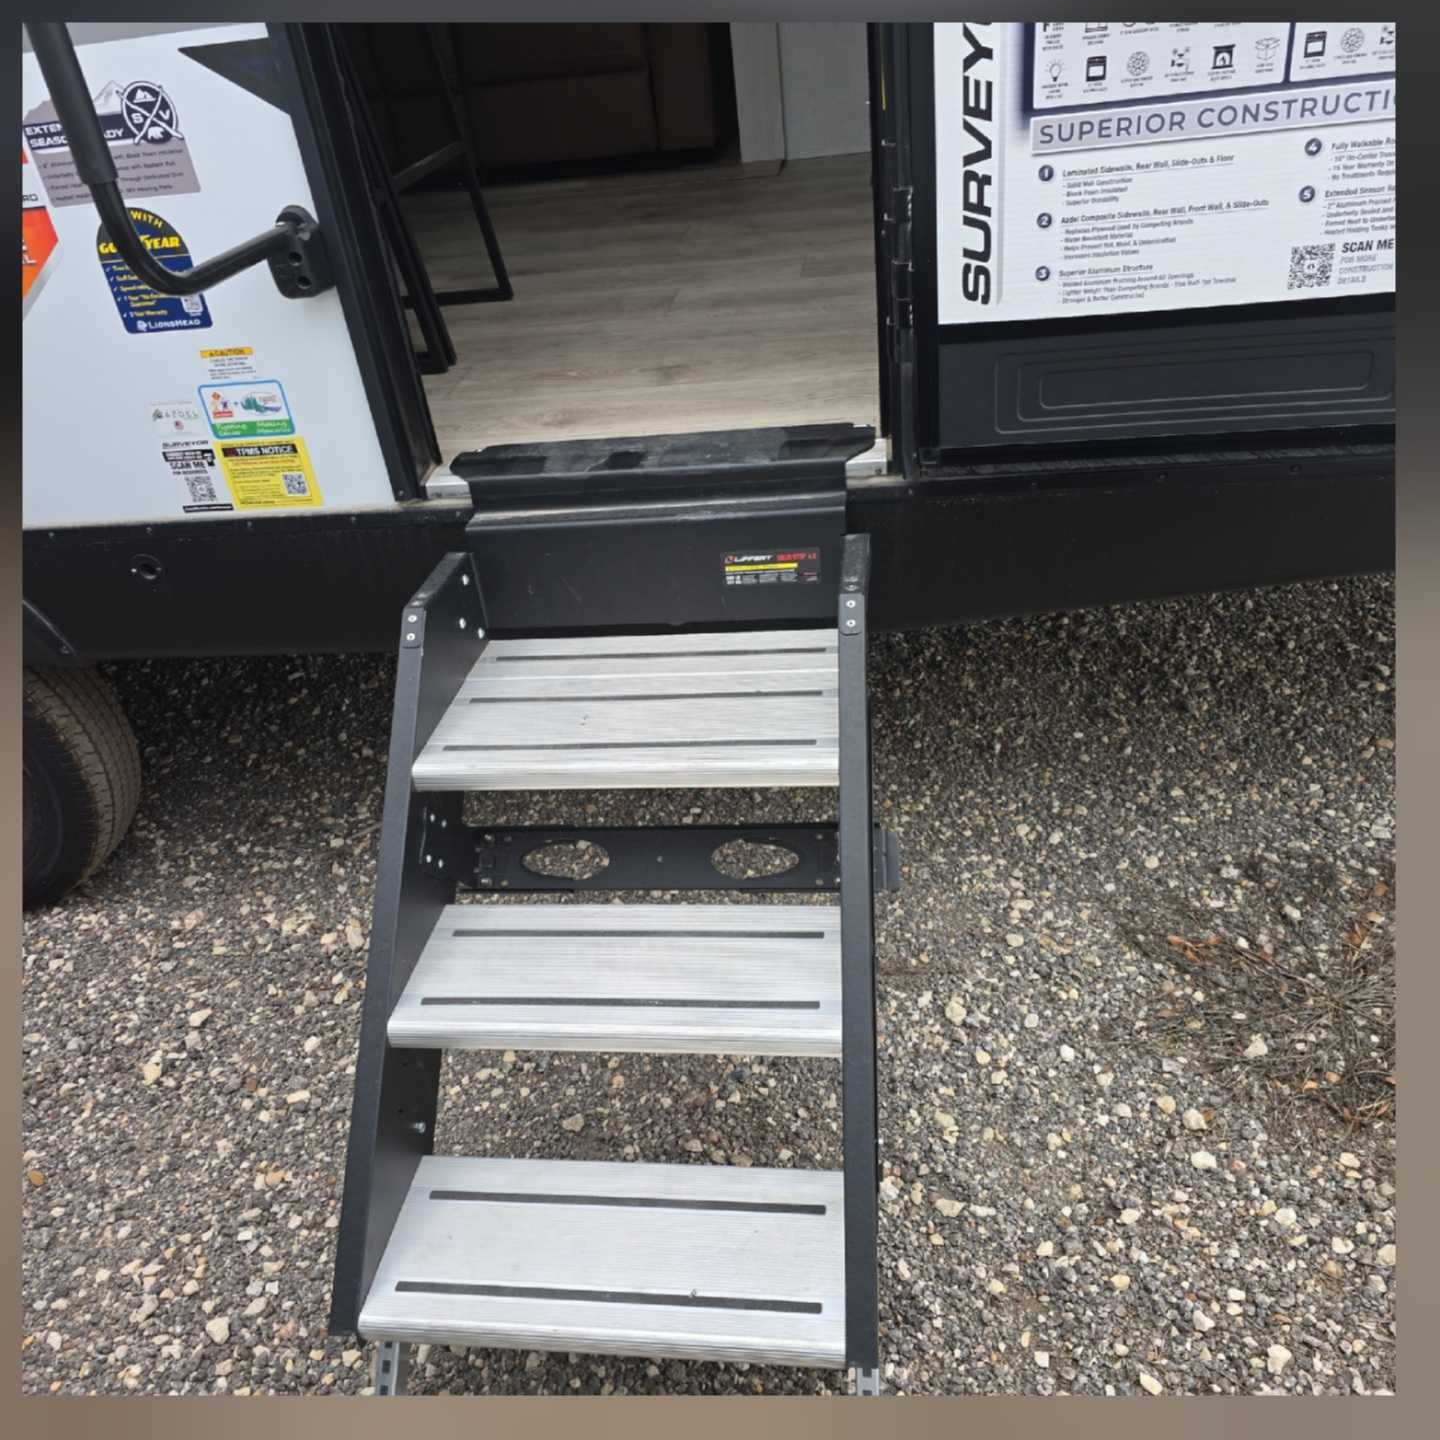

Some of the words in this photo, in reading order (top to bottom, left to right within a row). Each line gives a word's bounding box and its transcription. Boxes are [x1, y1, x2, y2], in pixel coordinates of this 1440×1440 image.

[1039, 112, 1186, 145] SUPERIOR
[1197, 89, 1396, 129] CONSTRUCTI
[962, 22, 994, 306] SURVEY
[130, 210, 164, 228] WITH
[1341, 240, 1374, 253] SCAN
[1376, 238, 1395, 251] ME
[262, 445, 293, 455] NOTICE
